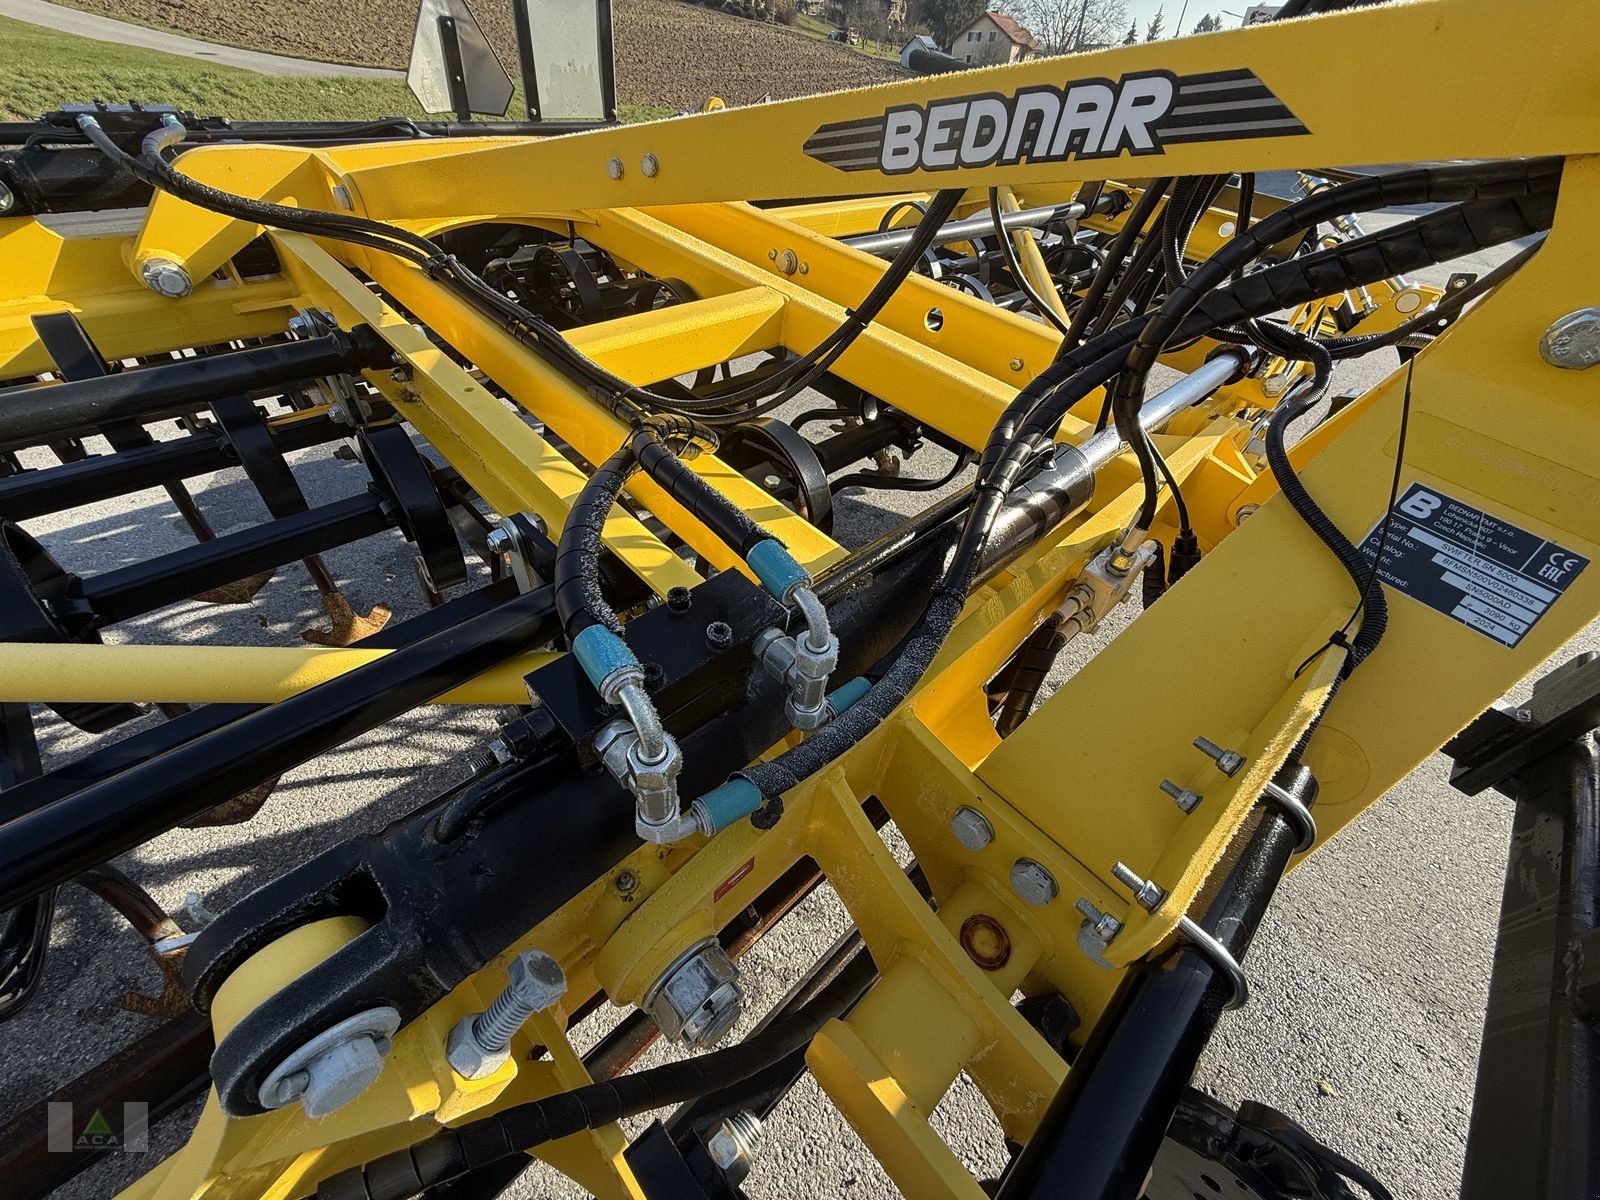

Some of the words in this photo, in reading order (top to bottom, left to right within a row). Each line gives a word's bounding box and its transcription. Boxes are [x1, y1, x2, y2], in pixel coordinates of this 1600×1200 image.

[882, 76, 1173, 171] BEDNAR
[1399, 490, 1442, 519] B
[1448, 503, 1480, 521] BEDNAR
[1481, 518, 1498, 528] FMT
[1439, 516, 1453, 525] 190
[1433, 521, 1456, 535] Czech
[1455, 530, 1487, 549] Republic
[1441, 543, 1481, 566] SWIFTER
[1481, 561, 1497, 573] SN
[1496, 569, 1519, 583] 5000
[1465, 583, 1512, 610] SN5000AD
[1473, 616, 1496, 631] 2024
[1484, 607, 1506, 621] 3090
[1508, 620, 1522, 631] kg
